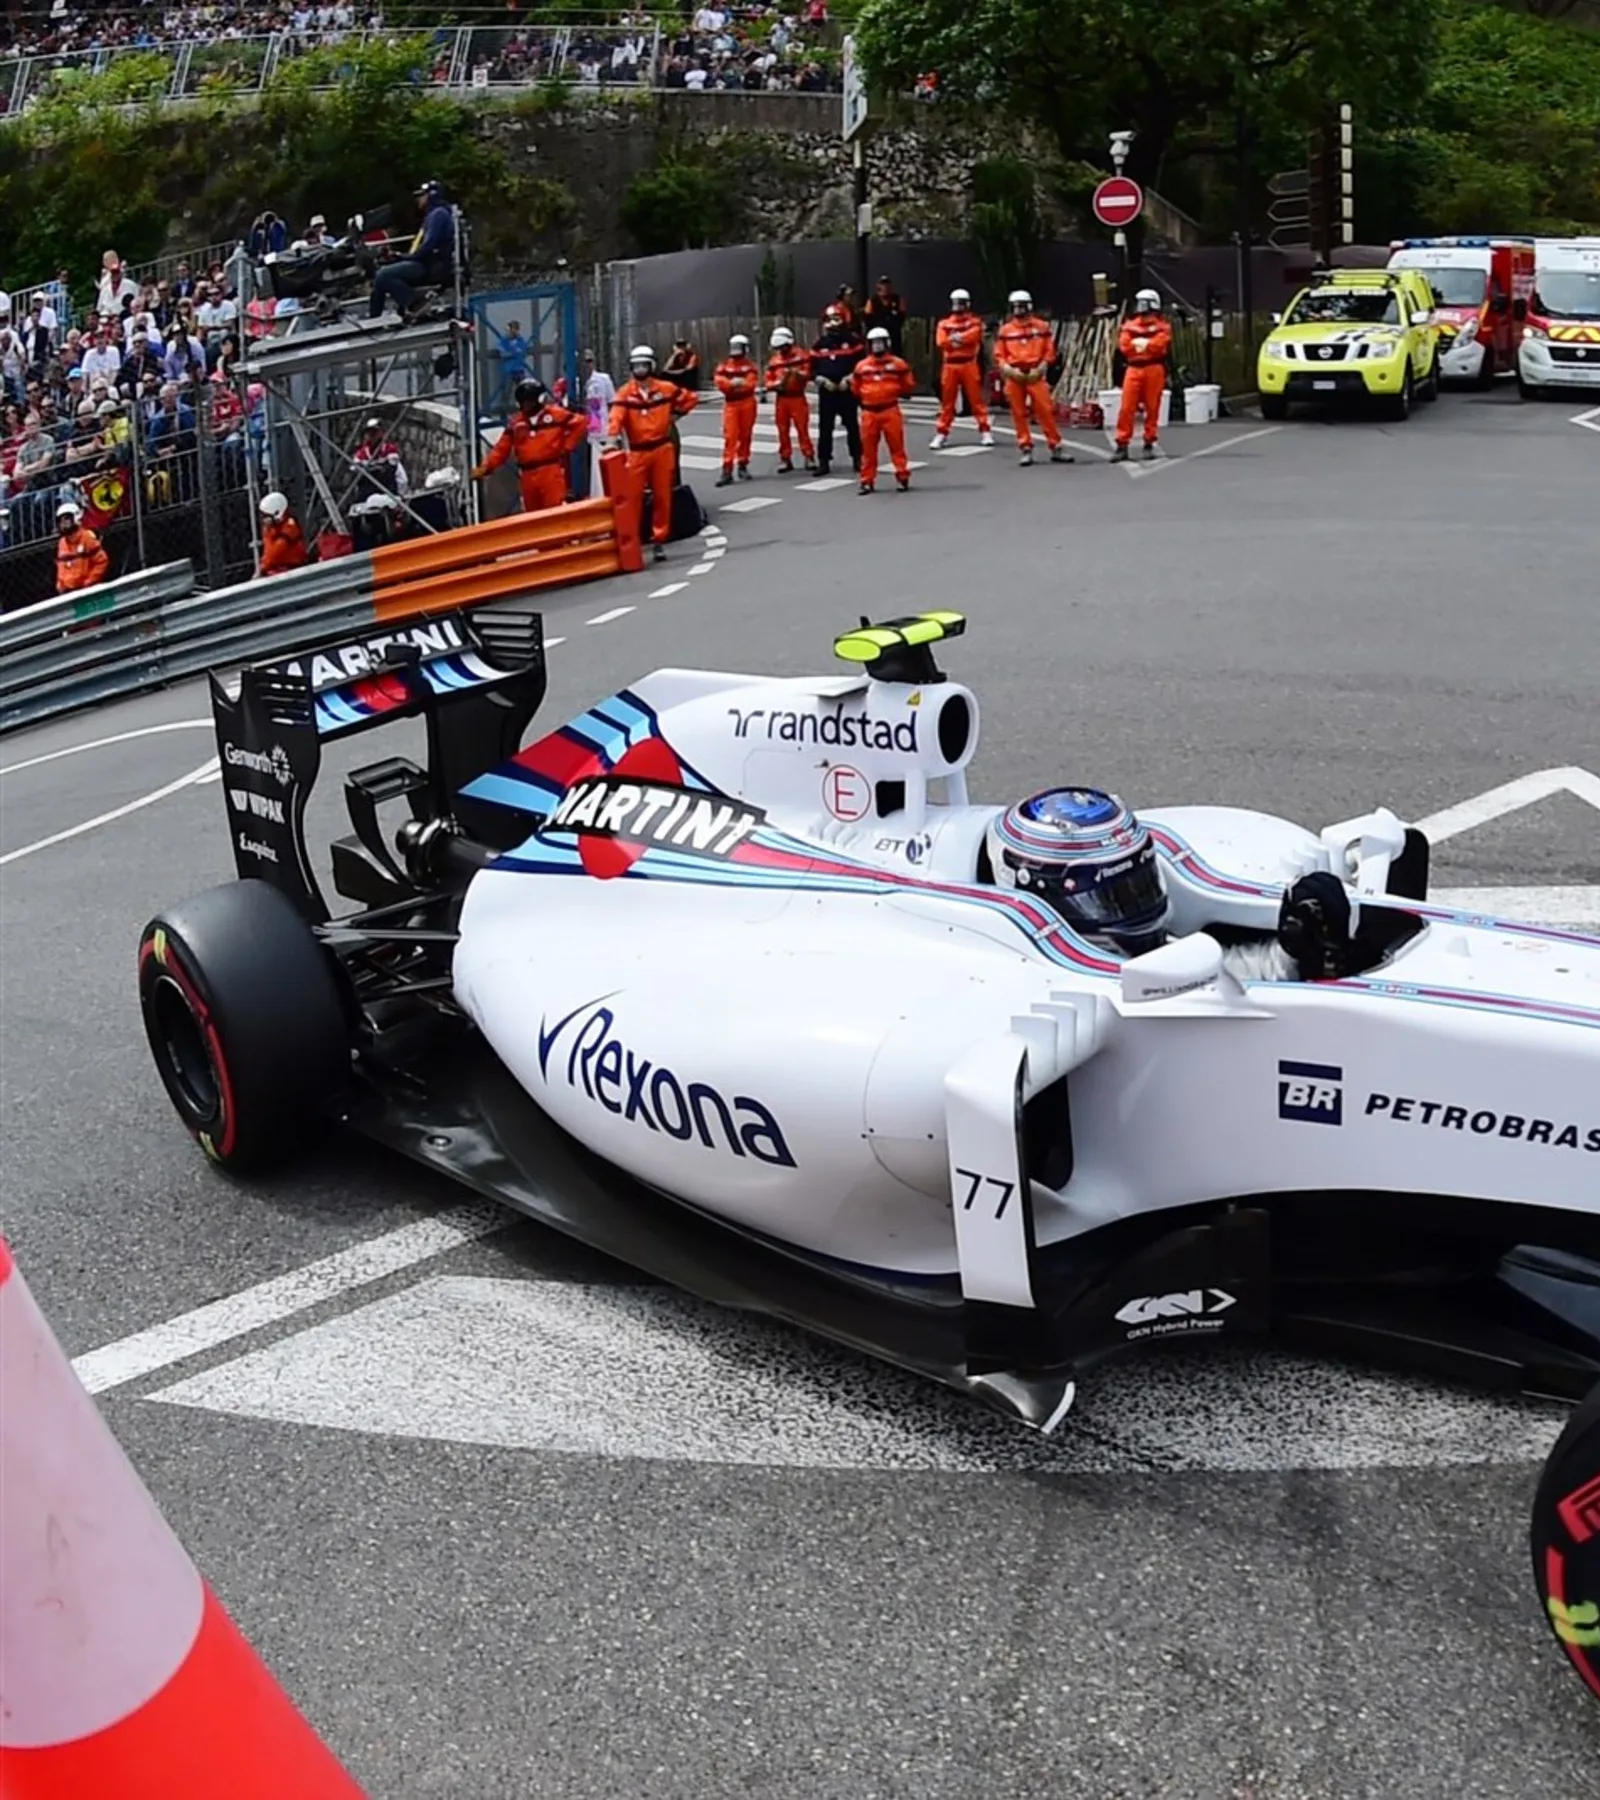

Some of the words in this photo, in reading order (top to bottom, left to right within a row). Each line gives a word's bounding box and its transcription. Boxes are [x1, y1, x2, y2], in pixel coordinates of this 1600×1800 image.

[767, 703, 919, 753] randstad
[834, 772, 858, 815] E
[543, 782, 757, 855] MARTINI
[874, 838, 905, 854] BT
[568, 1006, 798, 1168] Rexona
[1283, 1082, 1338, 1115] BR
[955, 1166, 1016, 1221] 77
[1153, 1320, 1188, 1333] Hybrid
[1190, 1319, 1224, 1329] Power
